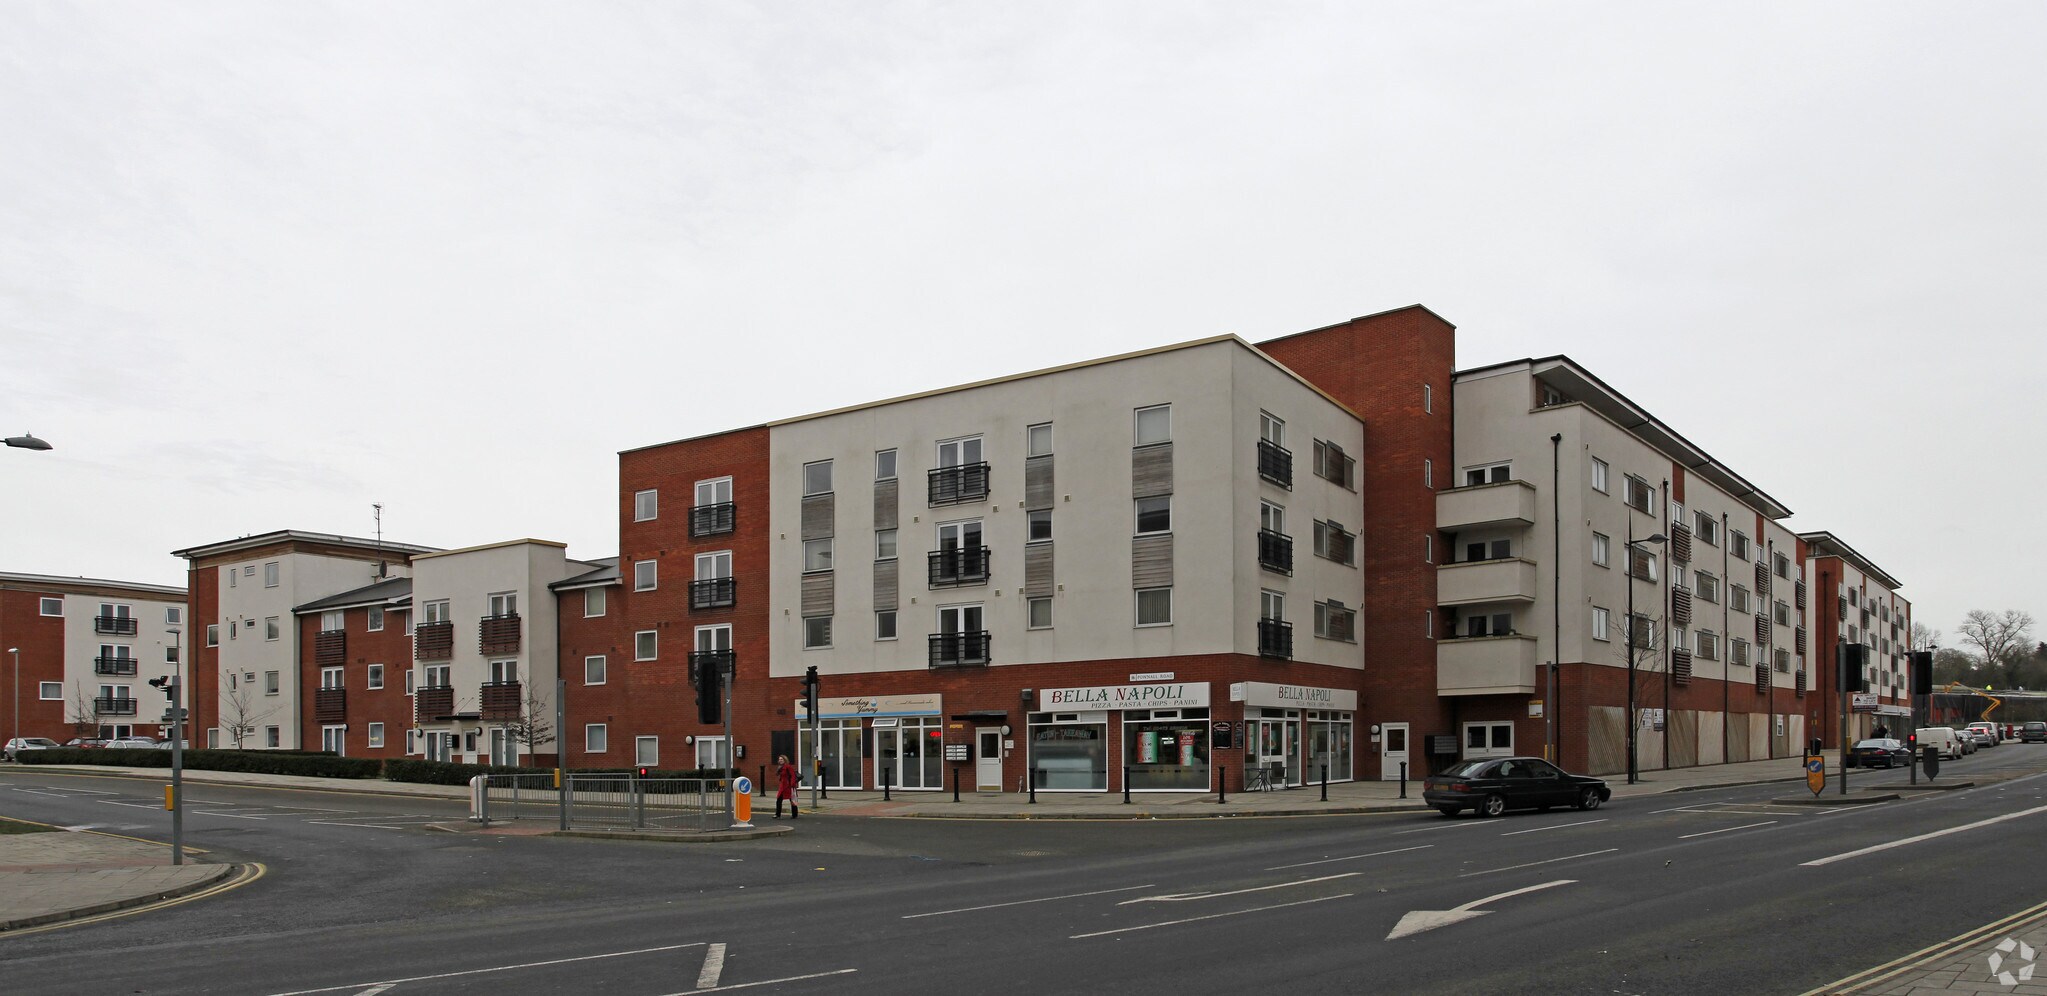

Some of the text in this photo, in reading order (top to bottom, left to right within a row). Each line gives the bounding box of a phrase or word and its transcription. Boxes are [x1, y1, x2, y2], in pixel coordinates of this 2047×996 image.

[1051, 685, 1184, 703] BELLA NAPOLI
[1278, 686, 1331, 702] BELLA NAPOLI
[841, 698, 869, 707] Something
[856, 705, 878, 714] Yummy
